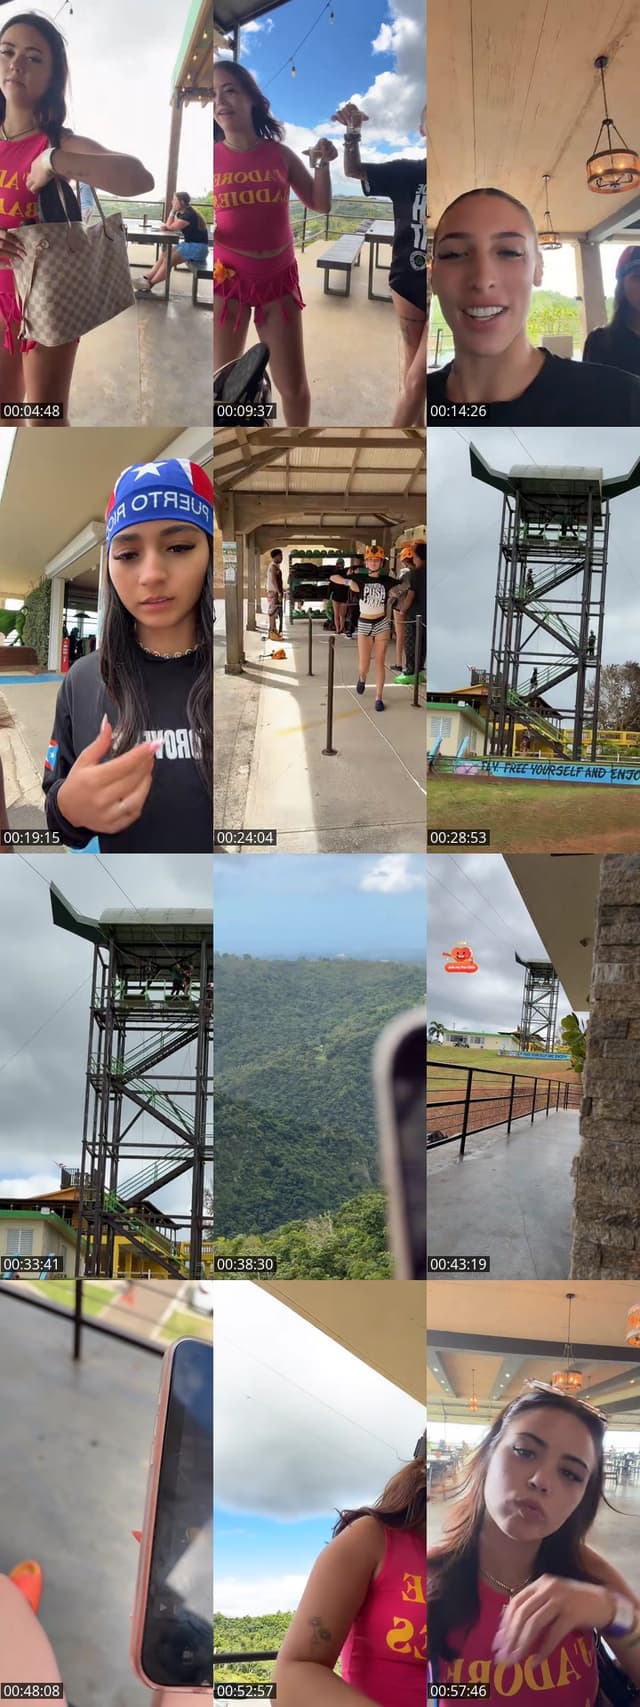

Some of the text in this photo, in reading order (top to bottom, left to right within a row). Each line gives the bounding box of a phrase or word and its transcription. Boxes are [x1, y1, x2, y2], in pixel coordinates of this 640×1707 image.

[503, 762, 529, 774] FREE
[531, 763, 583, 778] YOURSELF
[585, 767, 607, 779] AND
